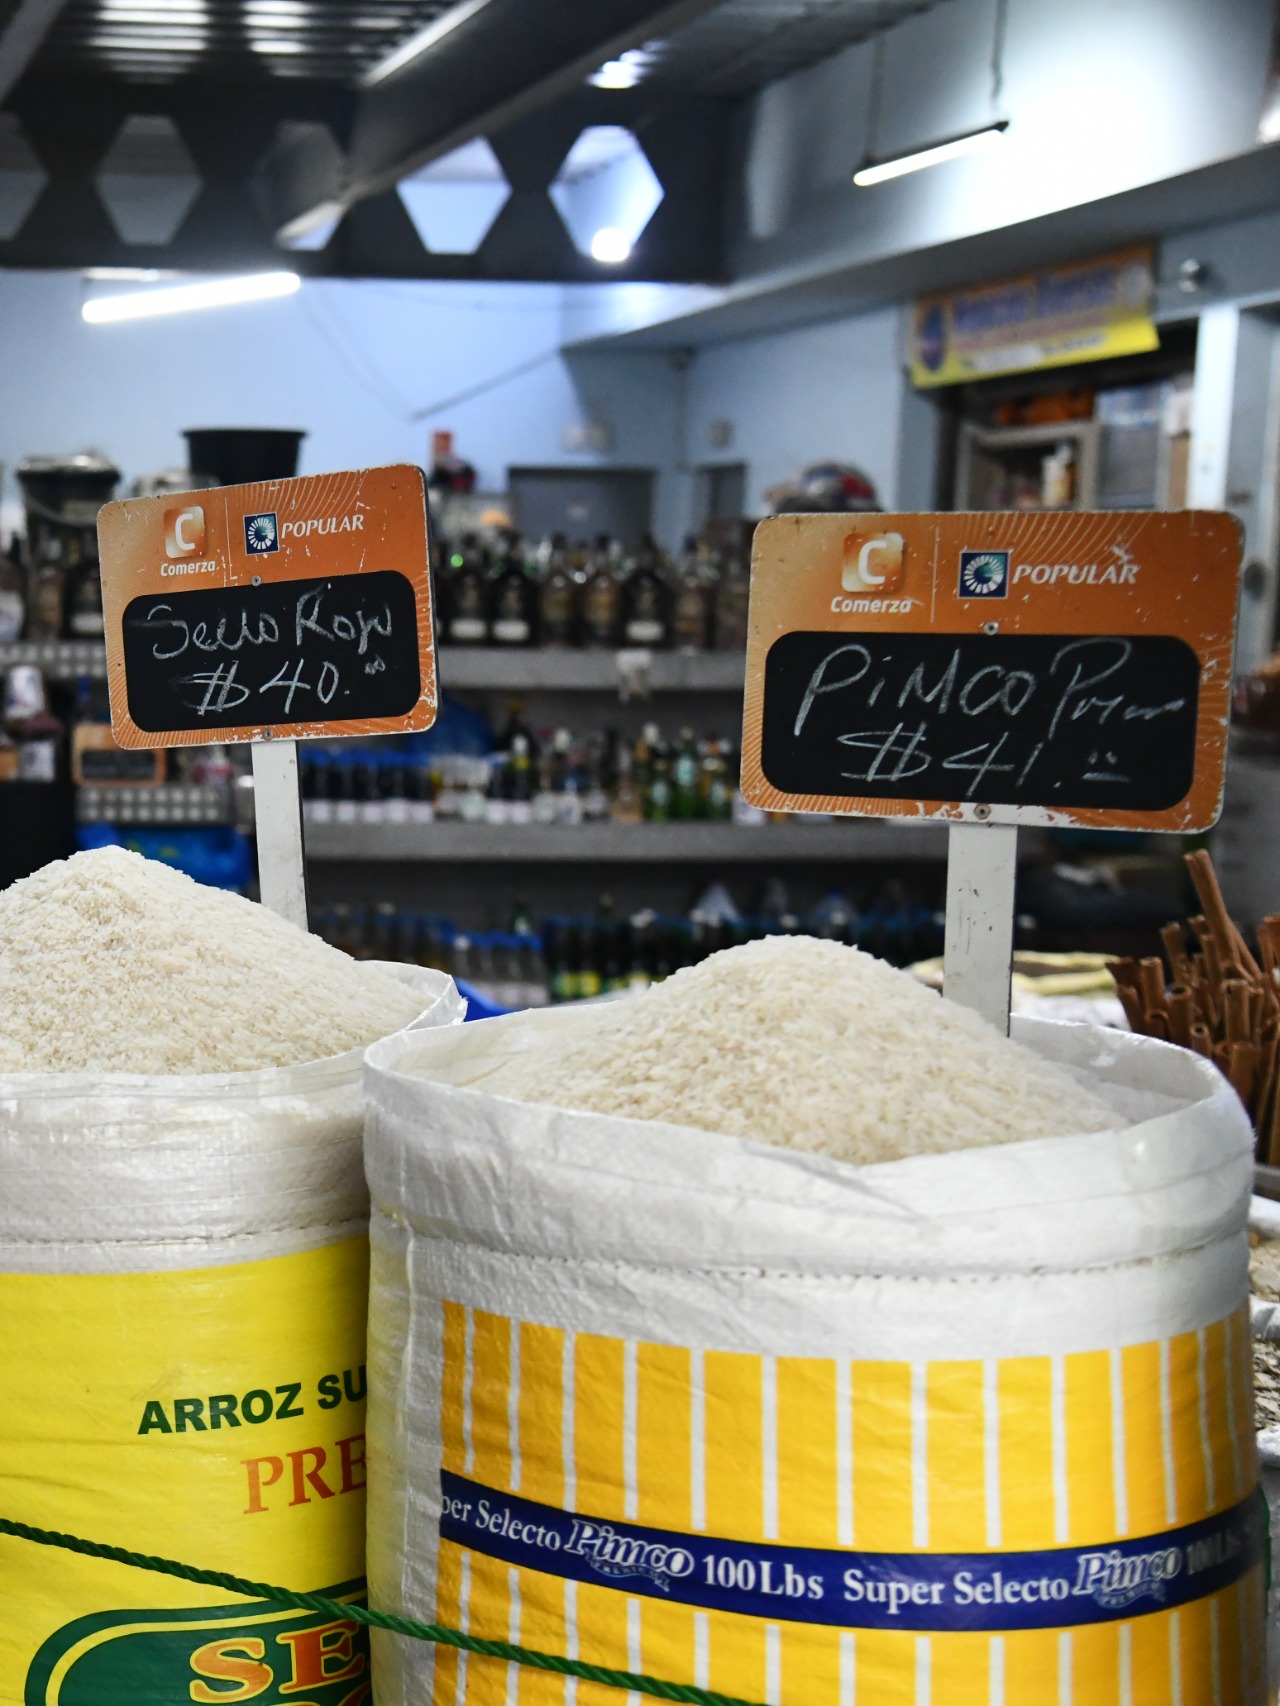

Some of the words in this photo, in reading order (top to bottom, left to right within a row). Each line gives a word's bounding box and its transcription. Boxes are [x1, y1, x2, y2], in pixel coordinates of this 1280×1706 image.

[281, 514, 365, 540] POPULAR
[160, 560, 216, 577] Comerza
[1012, 563, 1143, 586] POPULAR
[830, 596, 913, 614] Comerza
[147, 603, 280, 660] Sello
[137, 1381, 305, 1436] ARROZ
[240, 1432, 367, 1515] PRE
[475, 1499, 562, 1551] Selecto
[563, 1519, 695, 1578] Pimco
[843, 1568, 945, 1615] Super
[953, 1570, 1069, 1604] Selecto
[1072, 1546, 1183, 1596] Pimco
